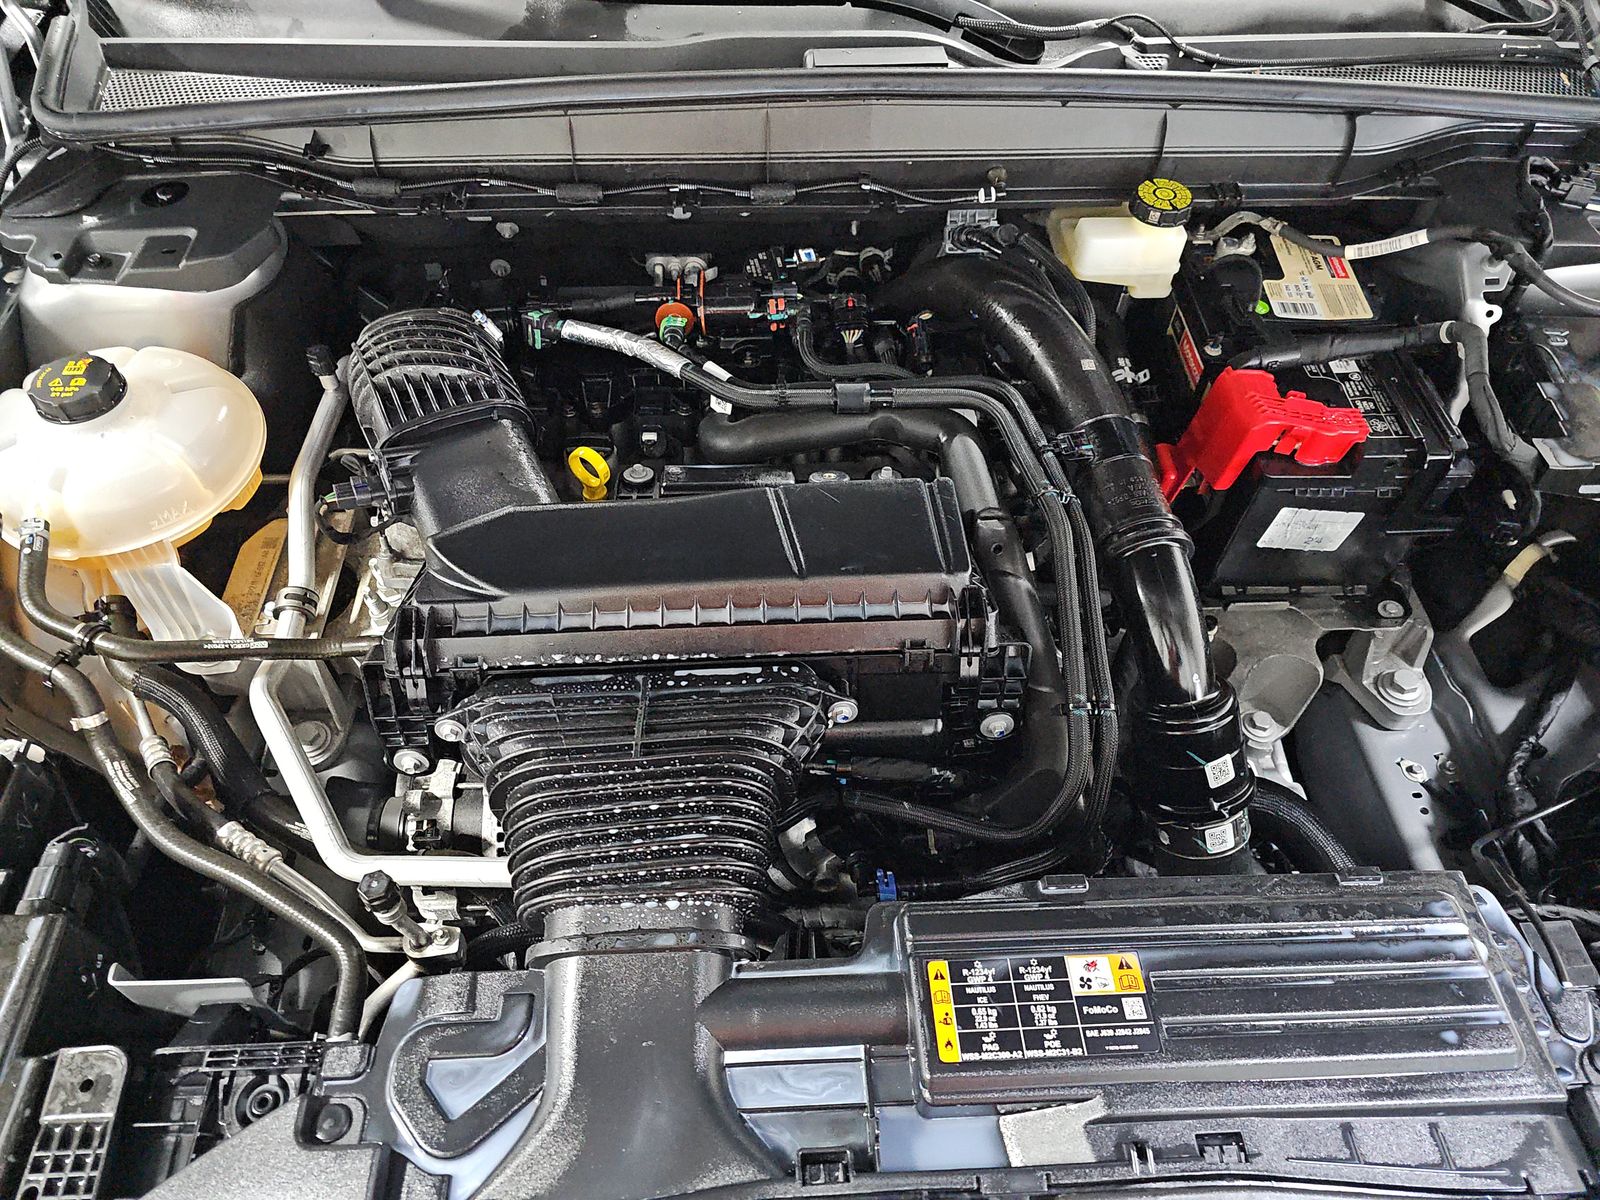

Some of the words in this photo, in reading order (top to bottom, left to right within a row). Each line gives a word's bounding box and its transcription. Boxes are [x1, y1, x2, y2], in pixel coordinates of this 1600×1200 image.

[1311, 255, 1324, 270] AGM
[962, 967, 996, 978] R-1234yf
[1019, 965, 1052, 976] R-1234yf
[987, 1007, 998, 1016] kg
[1047, 1005, 1057, 1014] kg
[1082, 1005, 1119, 1015] FoMoCo
[982, 1043, 1000, 1051] PAG
[1044, 1040, 1062, 1048] POE
